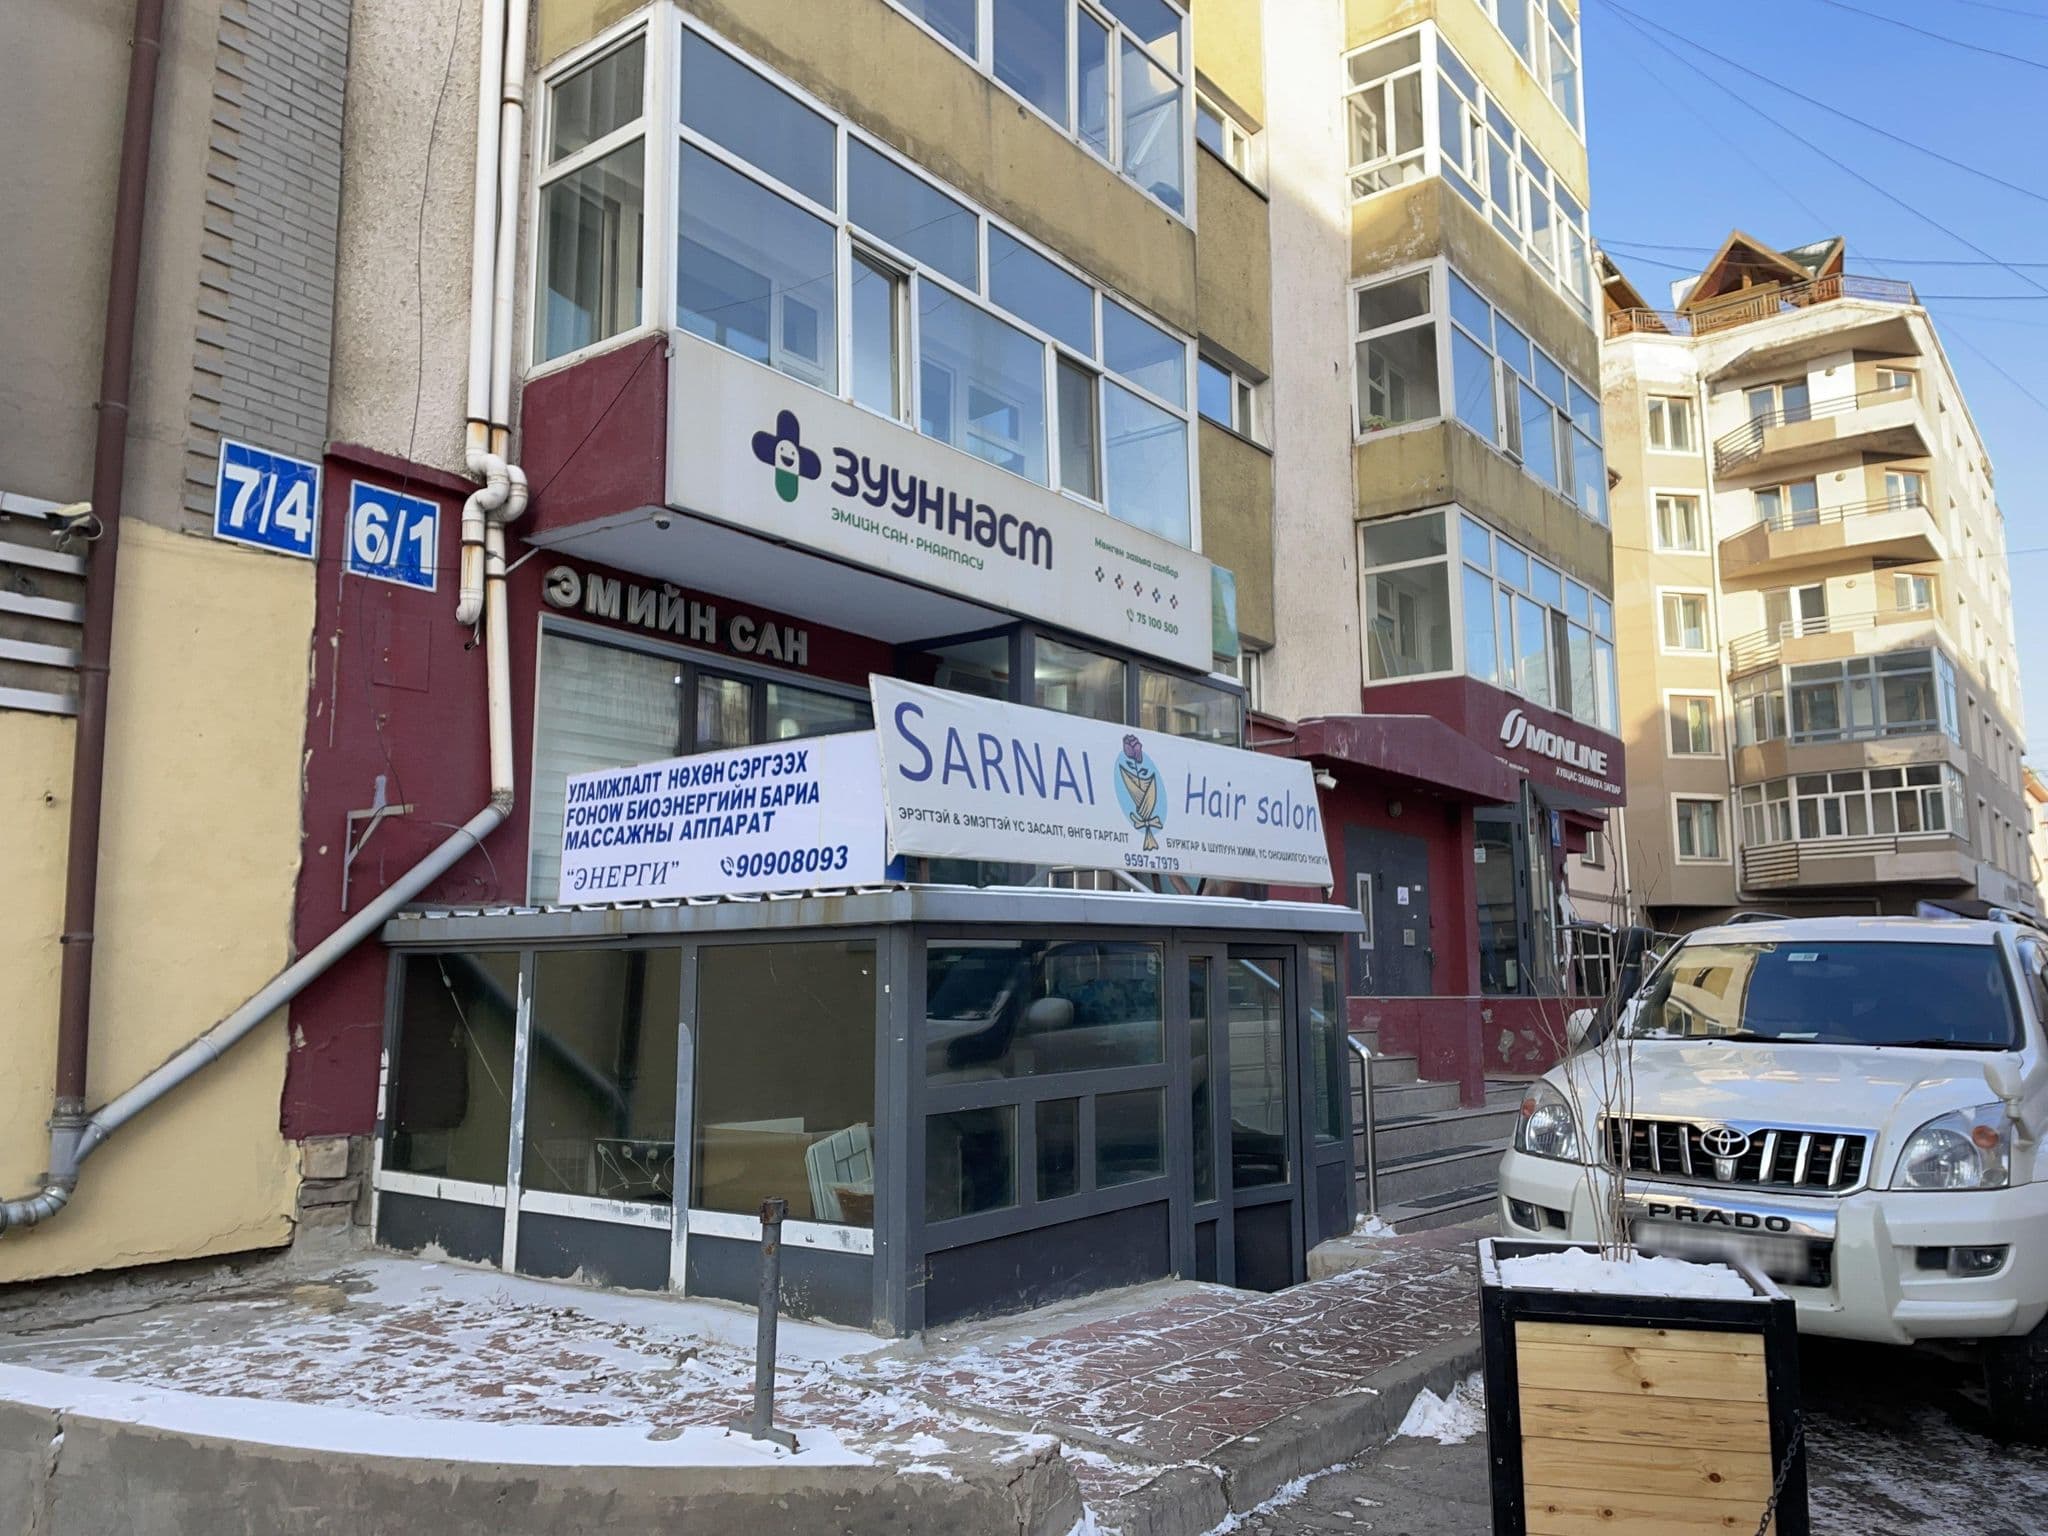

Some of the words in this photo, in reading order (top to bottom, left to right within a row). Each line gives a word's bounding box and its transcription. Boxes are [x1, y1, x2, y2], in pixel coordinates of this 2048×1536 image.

[223, 462, 312, 543] 7/4
[353, 501, 434, 574] 6/1
[882, 525, 908, 546] САН
[1152, 562, 1179, 579] салбар
[543, 565, 717, 644] ЭМИЙН
[729, 614, 808, 666] САН
[1136, 611, 1147, 625] 75
[1148, 615, 1162, 630] 100
[1163, 621, 1179, 636] 500
[567, 771, 662, 802] УЛАМЖЛАЛТ
[667, 760, 725, 792] НӨХӨН
[727, 750, 808, 782] СЭРГЭЭХ
[894, 701, 1096, 806] SARNAI
[1185, 772, 1247, 822] Hair
[1256, 788, 1319, 833] salon
[566, 799, 625, 829] FOHOW
[626, 783, 756, 819] БИОЭНЕРГИЙН
[760, 781, 820, 809] БАРИА
[898, 805, 951, 825] ЭРЭГТЭЙ
[953, 815, 961, 826] &
[962, 813, 1011, 832] ЭМЭГТЭЙ
[1013, 820, 1026, 833] ҮС
[1027, 821, 1067, 839] ЗАСАЛТ,
[1067, 826, 1092, 840] ӨНГӨ
[1093, 829, 1129, 844] ГАРГАЛТ
[564, 822, 673, 851] МАССАЖНЫ
[679, 811, 775, 841] АППАРАТ
[735, 845, 849, 878] 90908093
[1124, 852, 1149, 868] 9597
[1155, 854, 1180, 871] 7979
[1648, 1202, 1792, 1233] PRADO
